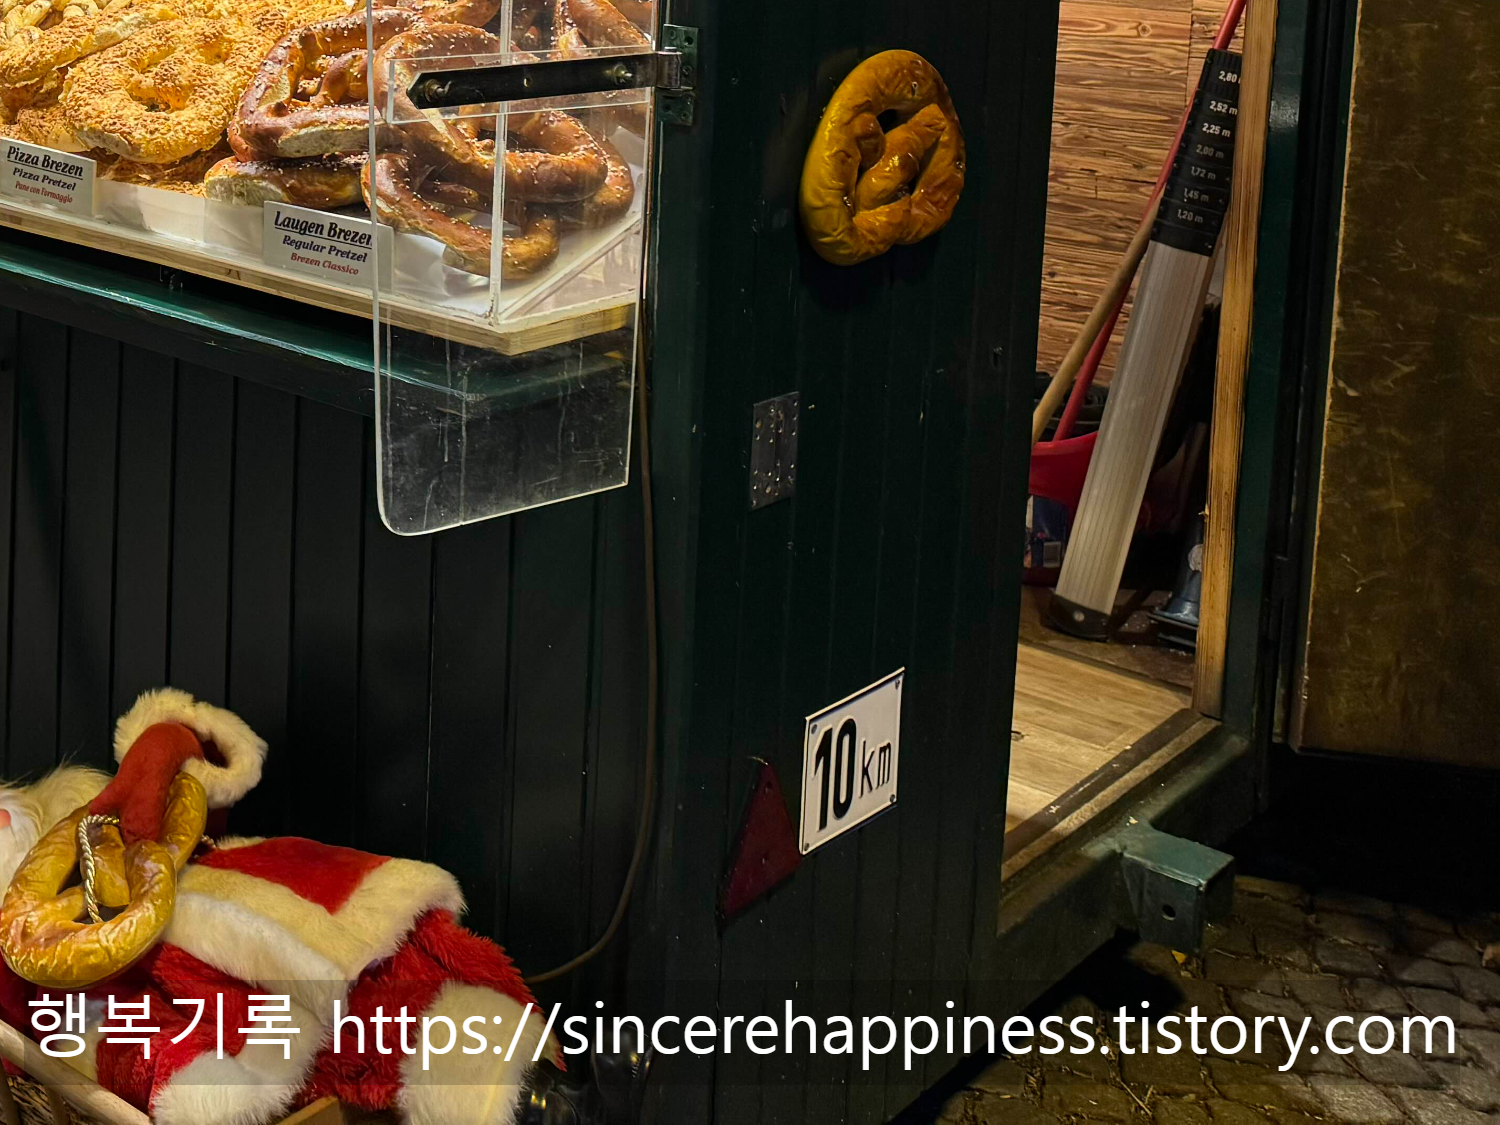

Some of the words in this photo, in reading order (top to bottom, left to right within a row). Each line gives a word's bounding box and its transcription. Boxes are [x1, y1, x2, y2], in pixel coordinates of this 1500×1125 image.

[1218, 71, 1238, 83] 2,80
[1209, 100, 1228, 113] 2,52
[1229, 107, 1238, 115] m
[1202, 122, 1221, 135] 2,25
[1222, 129, 1231, 137] m
[7, 145, 39, 166] Pizza
[41, 154, 83, 177] Brezen
[1215, 151, 1224, 159] m
[13, 167, 40, 182] Pizza
[41, 175, 77, 191] Pretzel
[1191, 166, 1206, 178] 1,72
[1207, 172, 1216, 180] m
[15, 181, 29, 191] Pane
[30, 186, 40, 195] con
[41, 188, 73, 204] Formaggio
[1200, 194, 1209, 202] m
[274, 211, 324, 235] Laugen
[1177, 209, 1193, 221] 1,20
[1194, 215, 1203, 223] m
[282, 235, 326, 253] Regular
[328, 245, 368, 263] Pretzel
[290, 252, 320, 267] Brezen
[322, 260, 359, 275] Classico
[814, 717, 857, 831] 10
[860, 740, 891, 798] km
